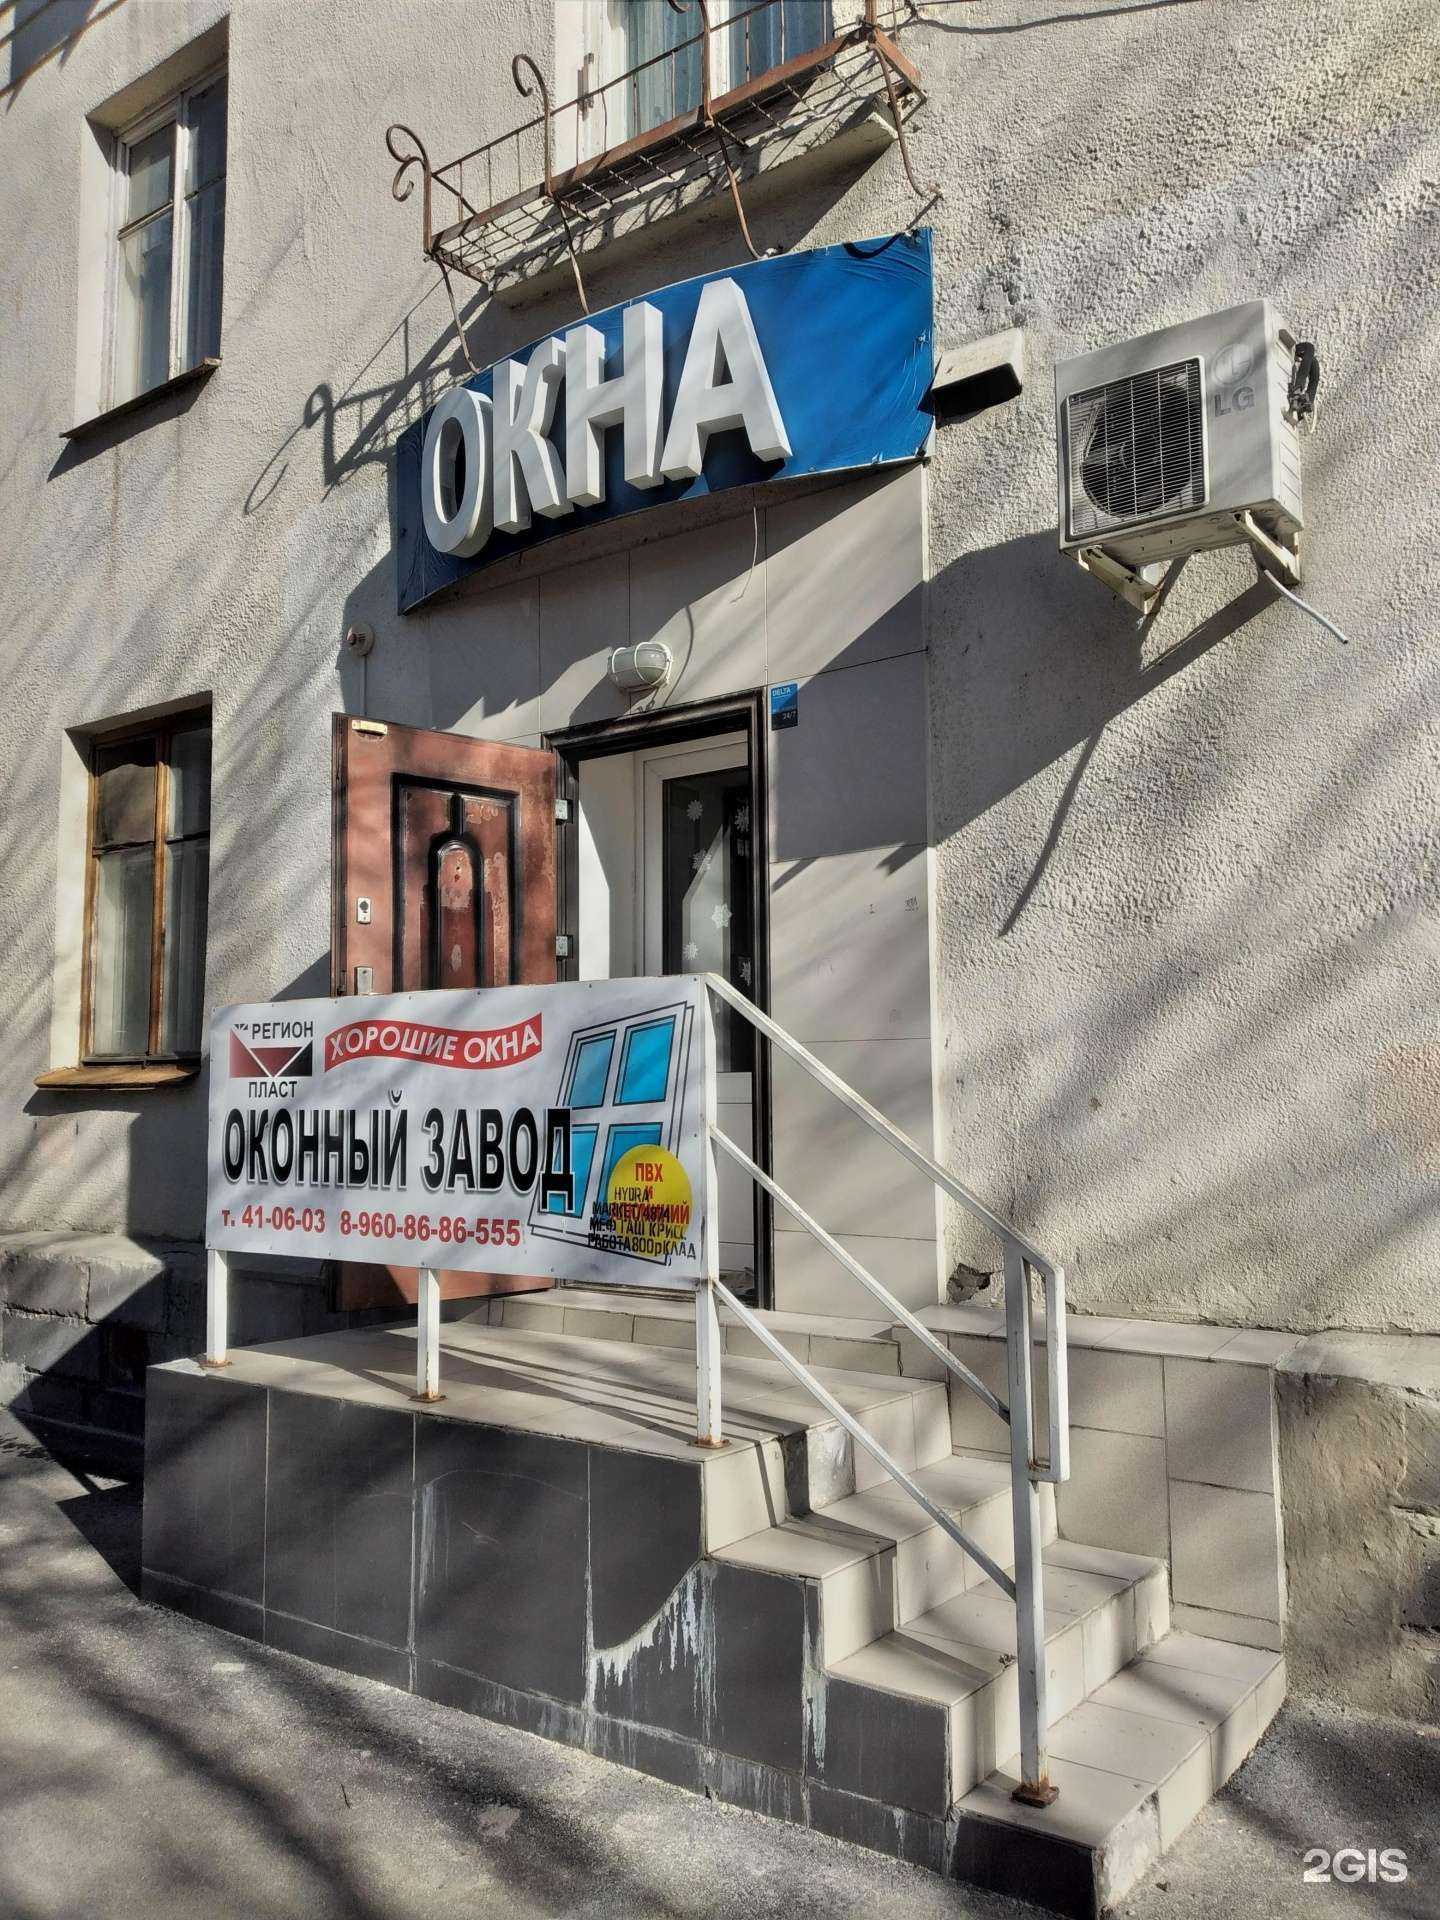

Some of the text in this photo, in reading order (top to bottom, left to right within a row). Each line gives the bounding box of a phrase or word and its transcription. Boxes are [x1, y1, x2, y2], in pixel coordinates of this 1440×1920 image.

[1214, 386, 1255, 417] LG
[421, 276, 793, 559] ОКНА
[772, 687, 791, 696] DELTA
[252, 1021, 314, 1040] РЕГИОН
[330, 1024, 540, 1063] ХОРОШИЕ ОКНА
[248, 1081, 298, 1098] ПЛАСТ
[223, 1089, 574, 1213] ОКОННЫЙ ЗАВОД
[635, 1163, 664, 1182] ПВХ
[241, 1204, 325, 1233] 41-06-03
[340, 1210, 520, 1246] 8-960-86-86-555
